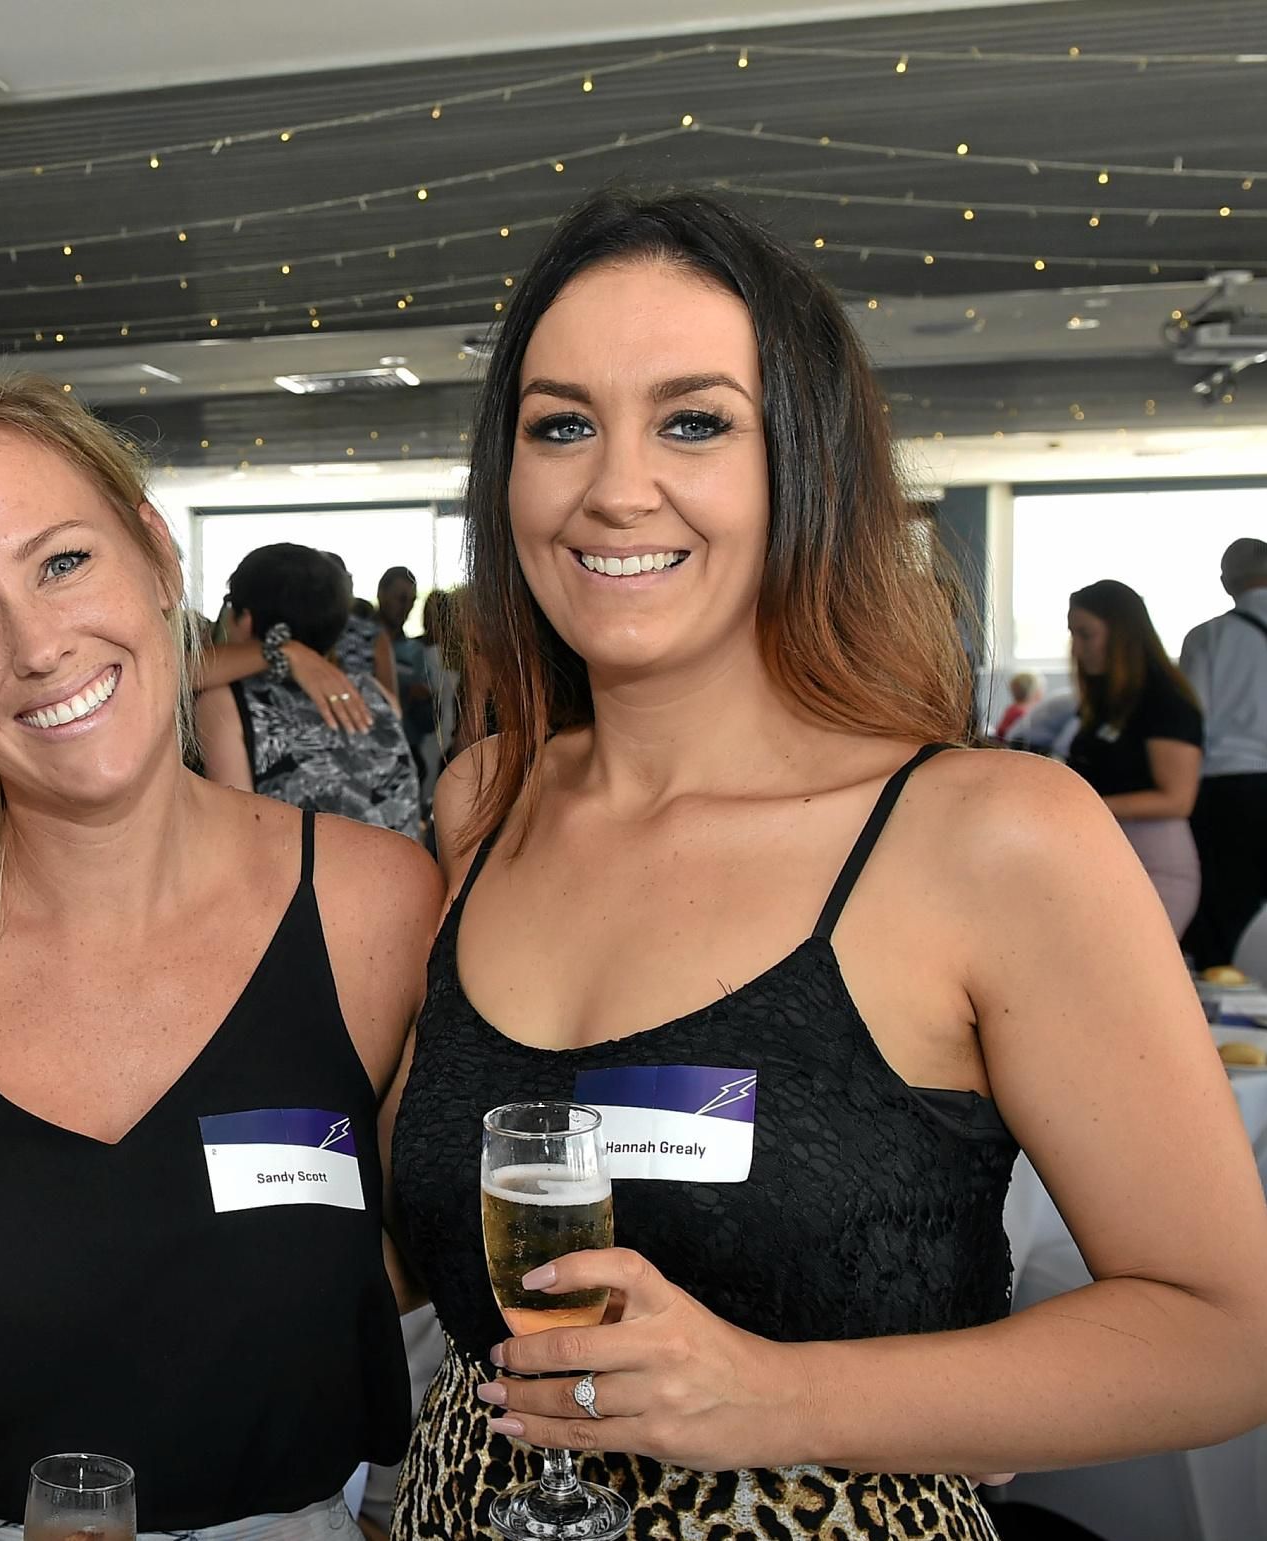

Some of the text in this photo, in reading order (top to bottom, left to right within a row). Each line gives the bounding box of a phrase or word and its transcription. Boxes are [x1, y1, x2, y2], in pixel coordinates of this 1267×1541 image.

[606, 1141, 707, 1159] Hannah Grealy
[257, 1171, 328, 1184] Sandy Scott
